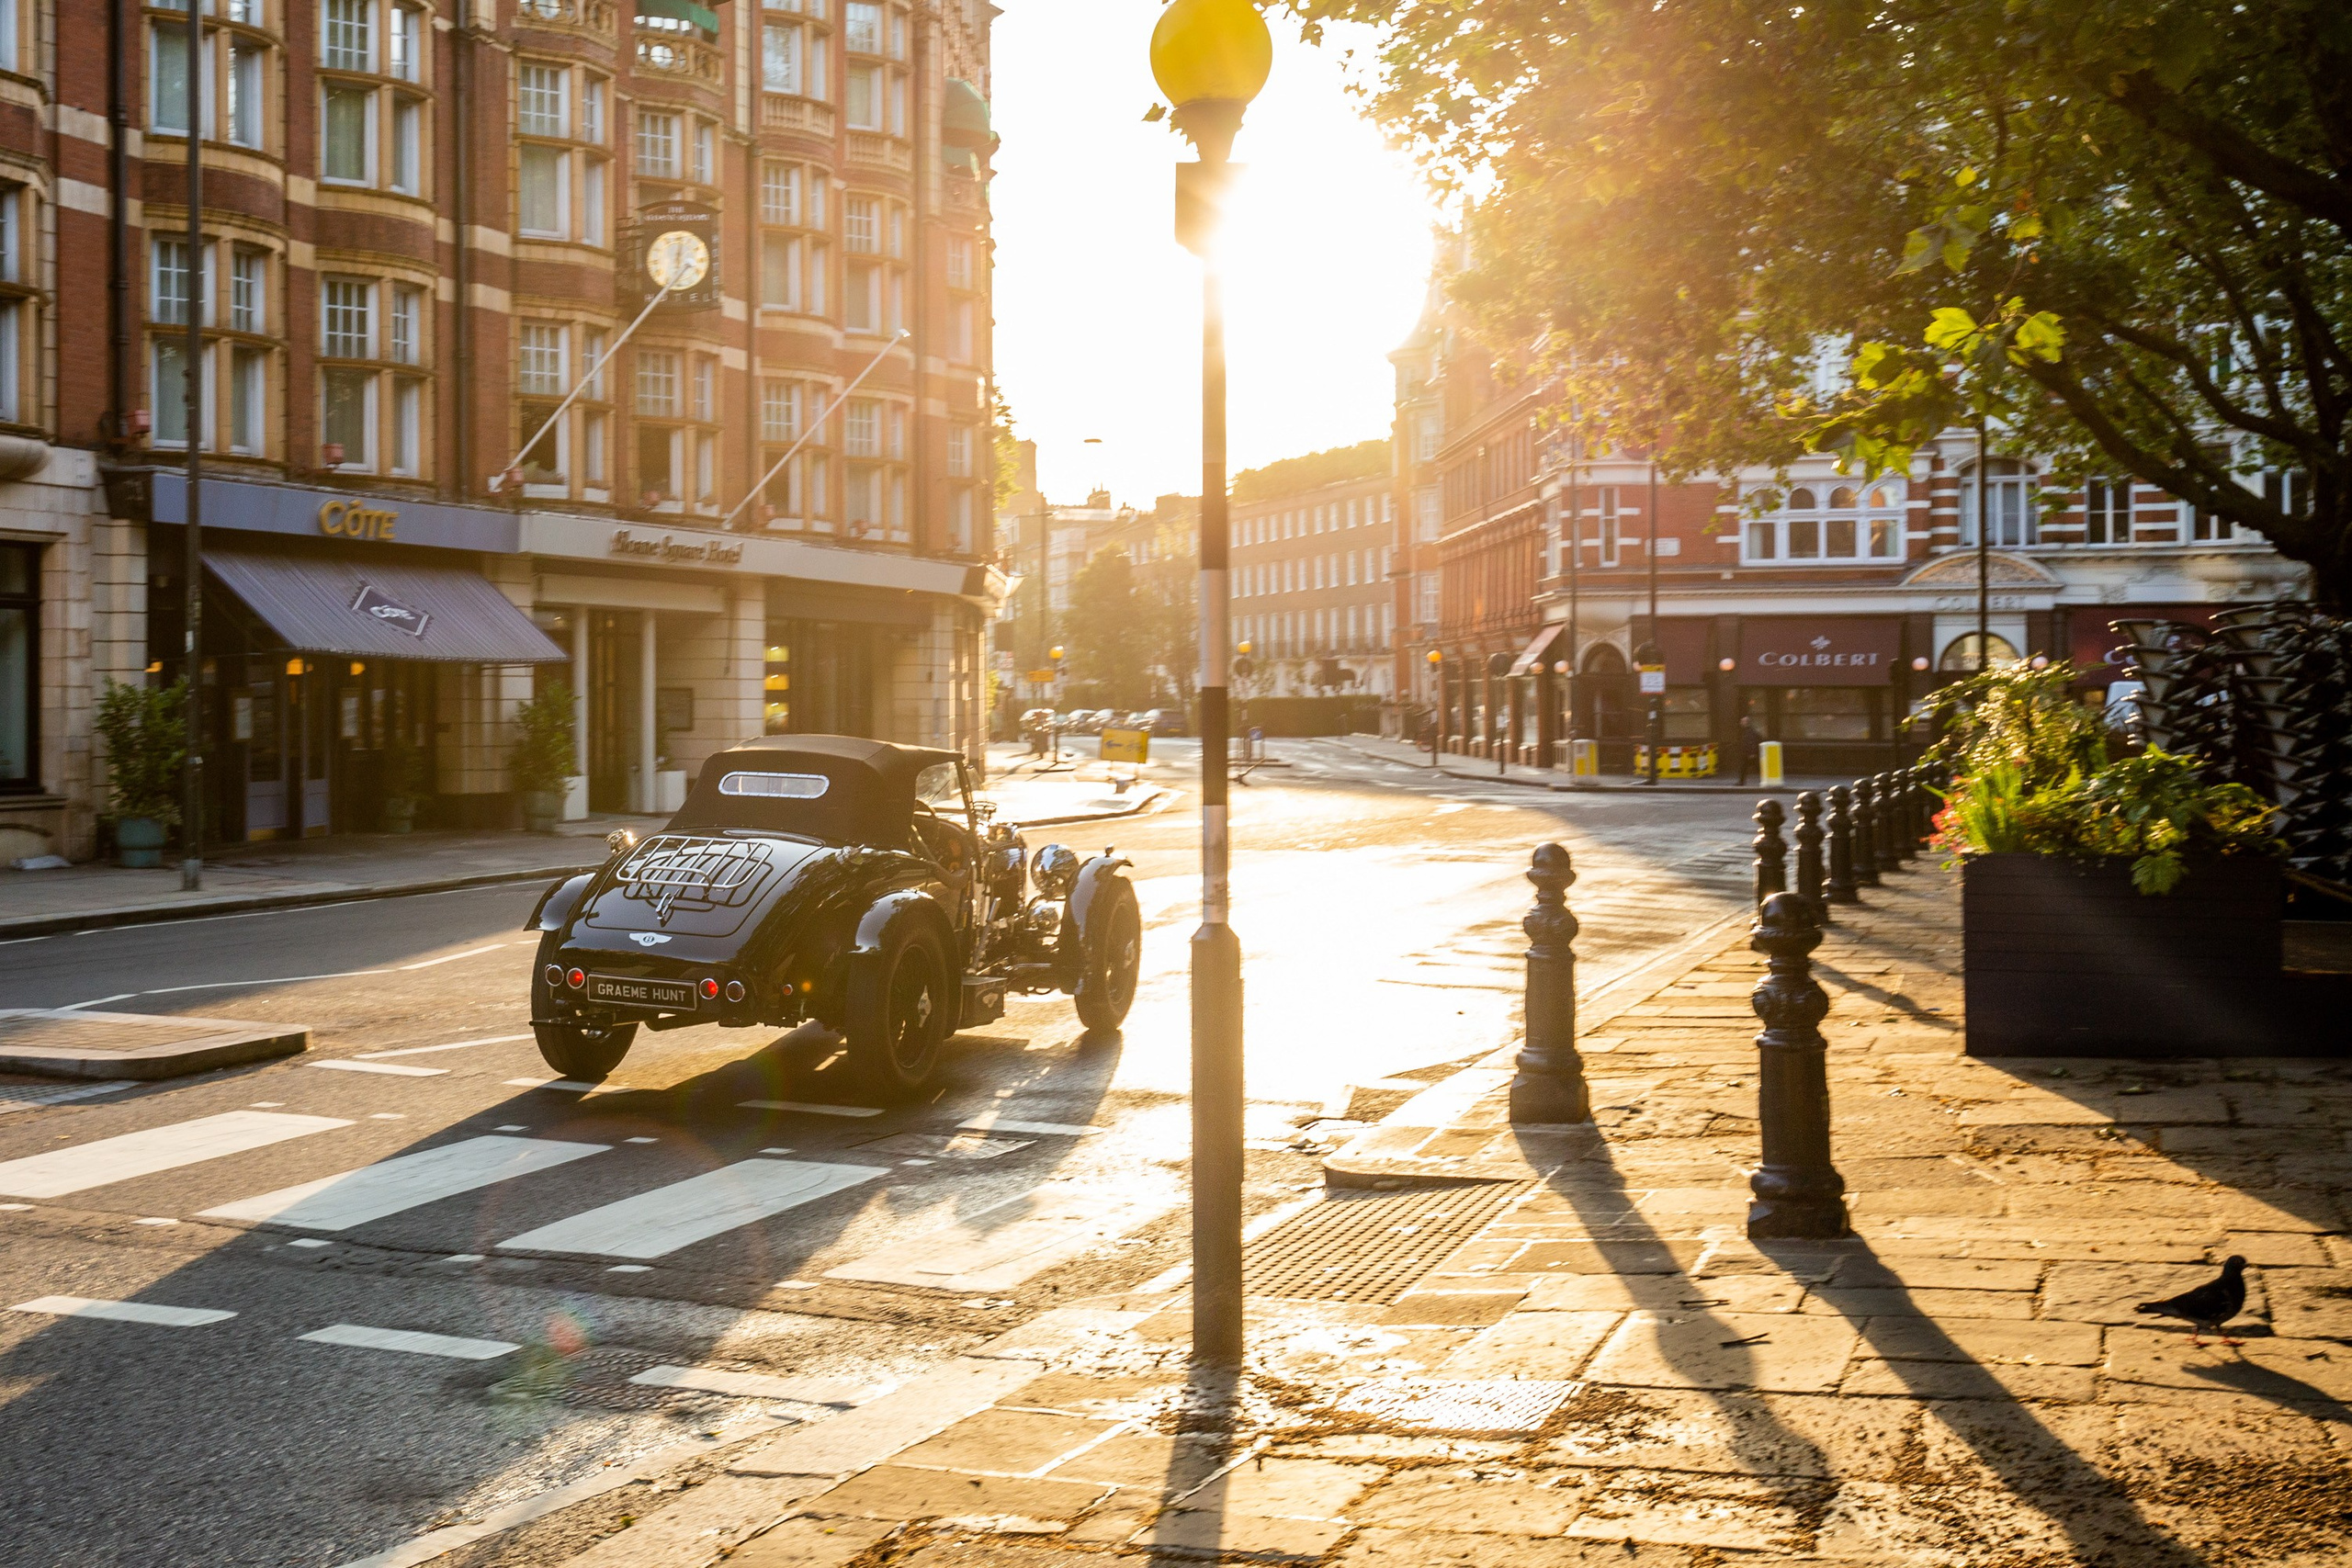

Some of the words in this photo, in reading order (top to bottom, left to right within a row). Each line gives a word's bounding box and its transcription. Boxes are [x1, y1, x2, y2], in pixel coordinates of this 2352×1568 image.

[1758, 651, 1880, 666] COLBERT
[597, 983, 648, 998] GRAEME
[652, 987, 686, 1002] HUNT
